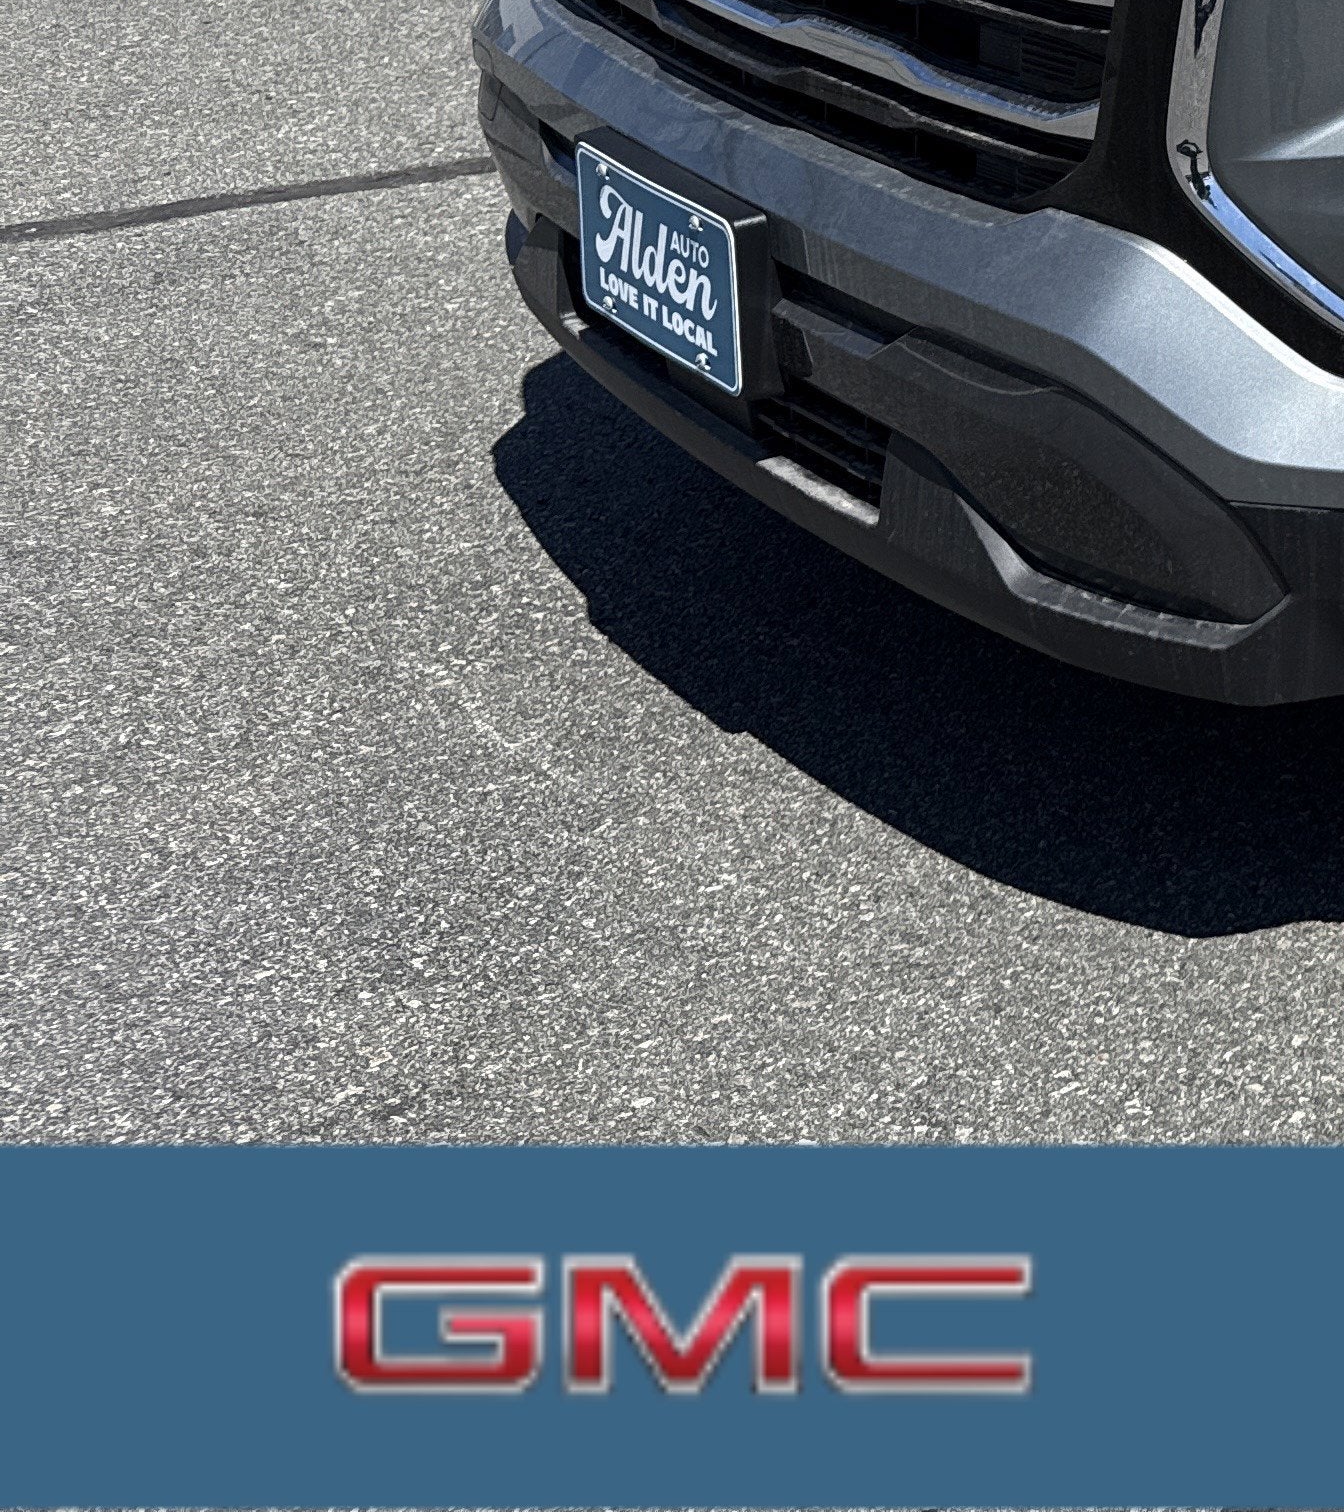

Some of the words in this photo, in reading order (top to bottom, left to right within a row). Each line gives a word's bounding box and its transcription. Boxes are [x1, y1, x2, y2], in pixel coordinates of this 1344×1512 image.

[595, 184, 718, 321] Alden
[670, 230, 710, 269] AUTO
[599, 266, 639, 311] LOVE
[642, 294, 660, 323] IT
[662, 304, 719, 357] LOCAL
